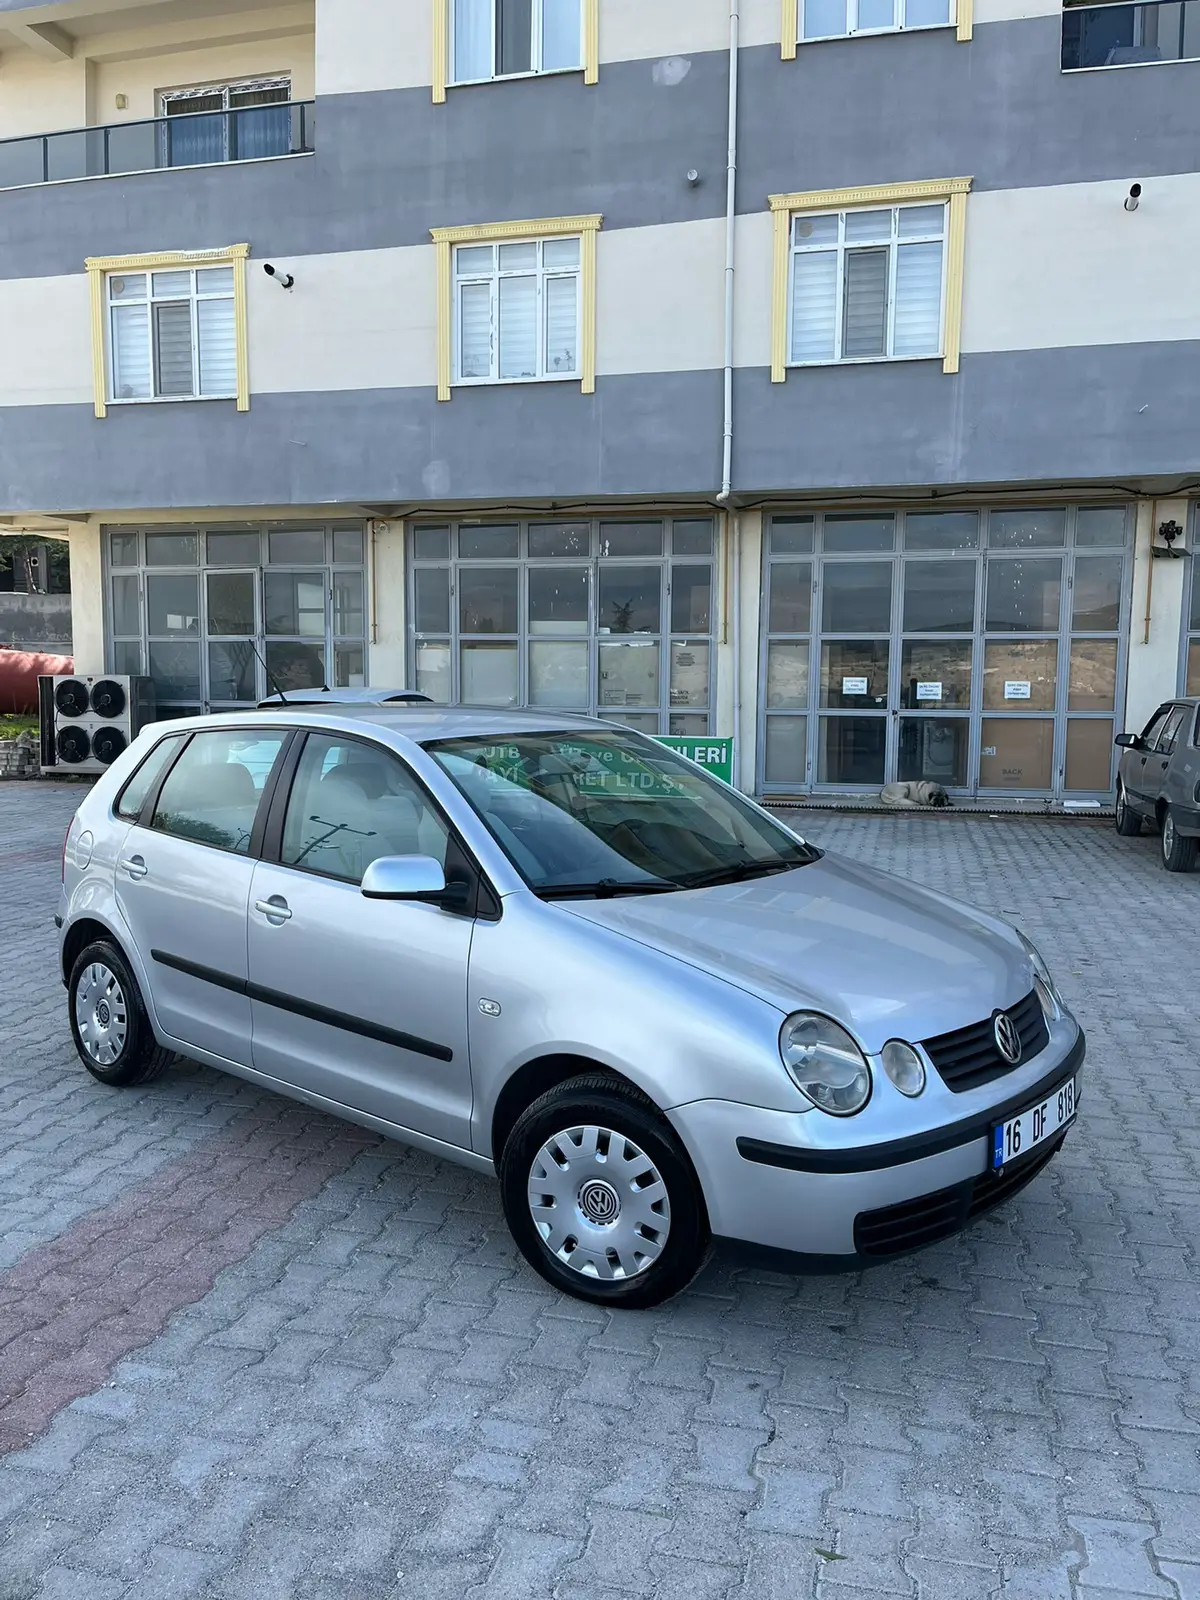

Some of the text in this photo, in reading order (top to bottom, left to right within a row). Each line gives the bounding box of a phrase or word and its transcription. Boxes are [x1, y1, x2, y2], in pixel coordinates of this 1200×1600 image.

[1006, 1119, 1022, 1157] 16
[1032, 1103, 1048, 1142] DF
[1057, 1082, 1073, 1123] 818
